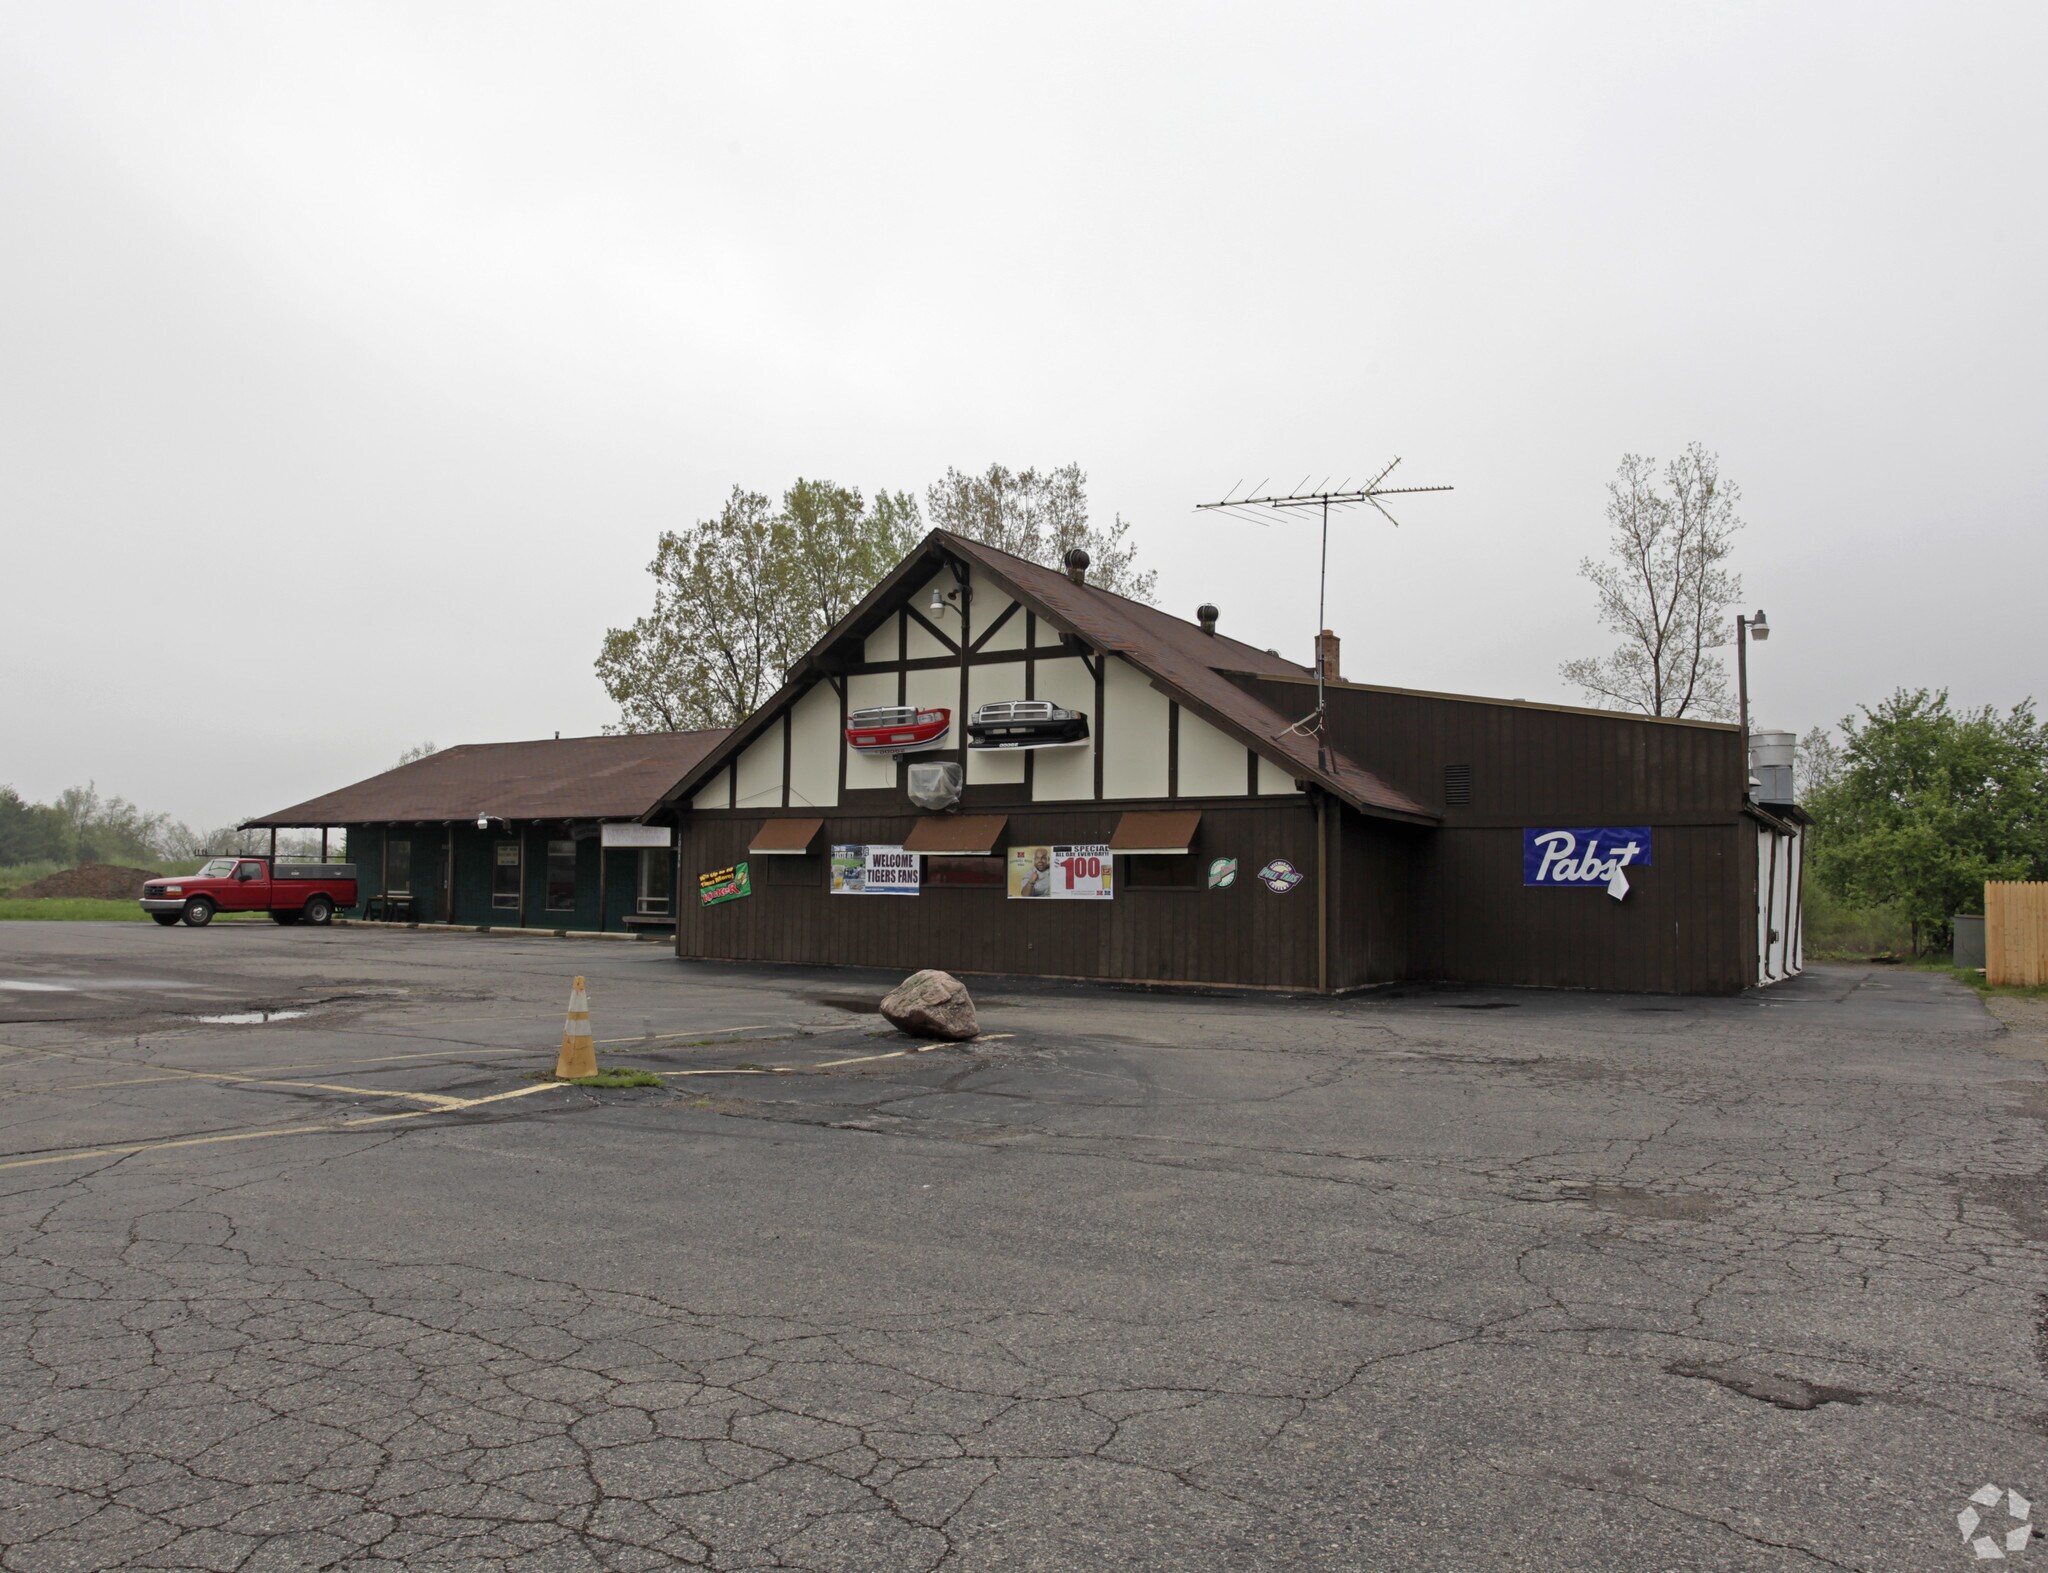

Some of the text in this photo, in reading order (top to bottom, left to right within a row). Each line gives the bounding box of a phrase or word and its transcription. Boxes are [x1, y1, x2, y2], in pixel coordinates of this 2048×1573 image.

[873, 854, 913, 868] WELCOME
[1534, 830, 1640, 882] Pabst
[867, 869, 918, 884] TIGERS FANS
